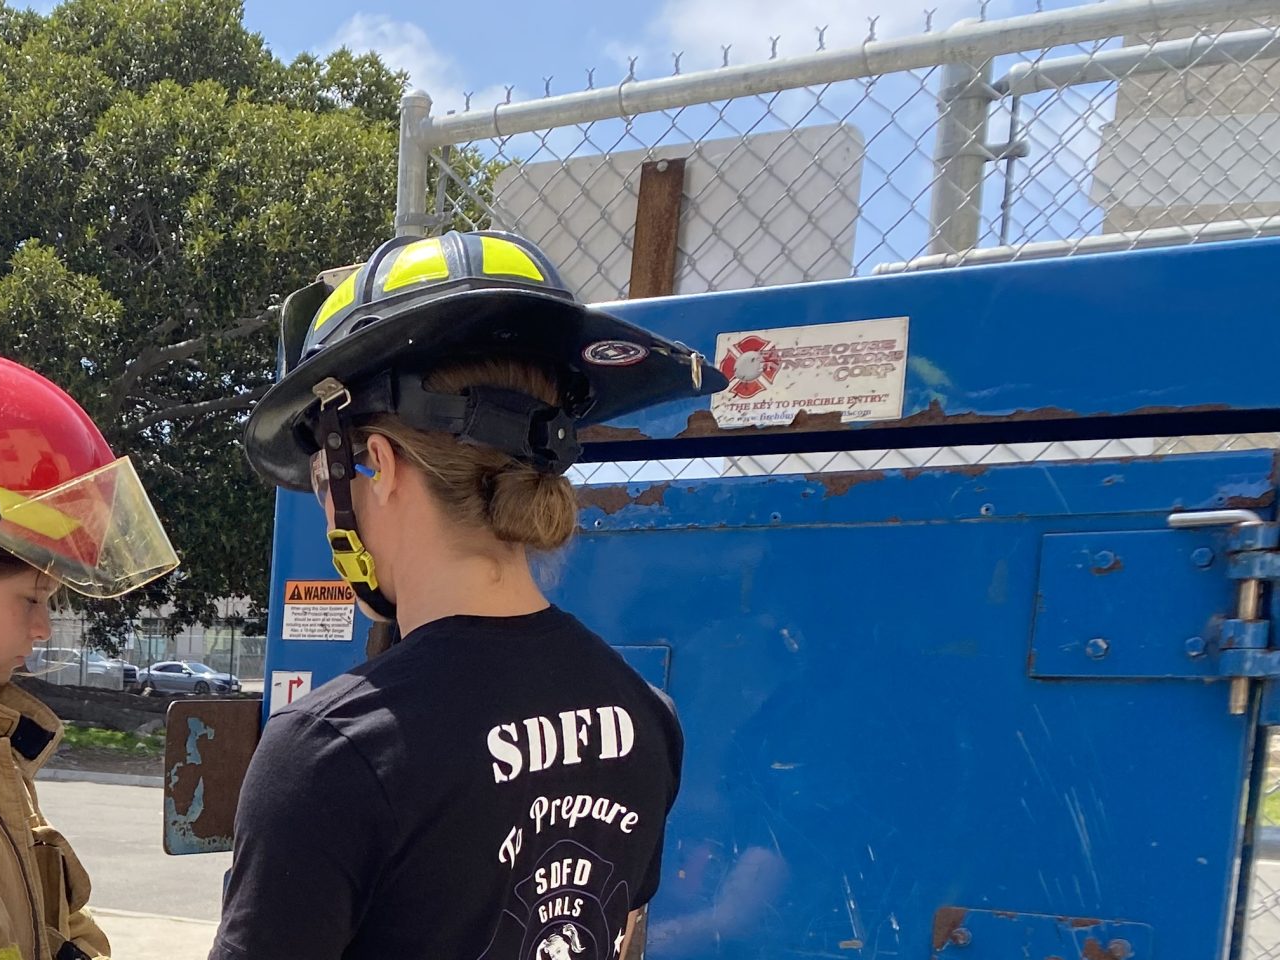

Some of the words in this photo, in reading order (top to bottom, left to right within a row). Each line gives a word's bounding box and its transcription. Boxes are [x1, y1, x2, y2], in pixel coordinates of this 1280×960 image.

[752, 400, 774, 411] KEY
[776, 400, 790, 409] TO
[792, 397, 844, 408] FORCIBLE
[304, 586, 354, 600] WARNING
[487, 706, 635, 784] SDFD
[498, 825, 523, 870] To
[529, 794, 639, 834] Prepare
[535, 858, 591, 895] SDFD
[538, 896, 584, 924] GIRLS
